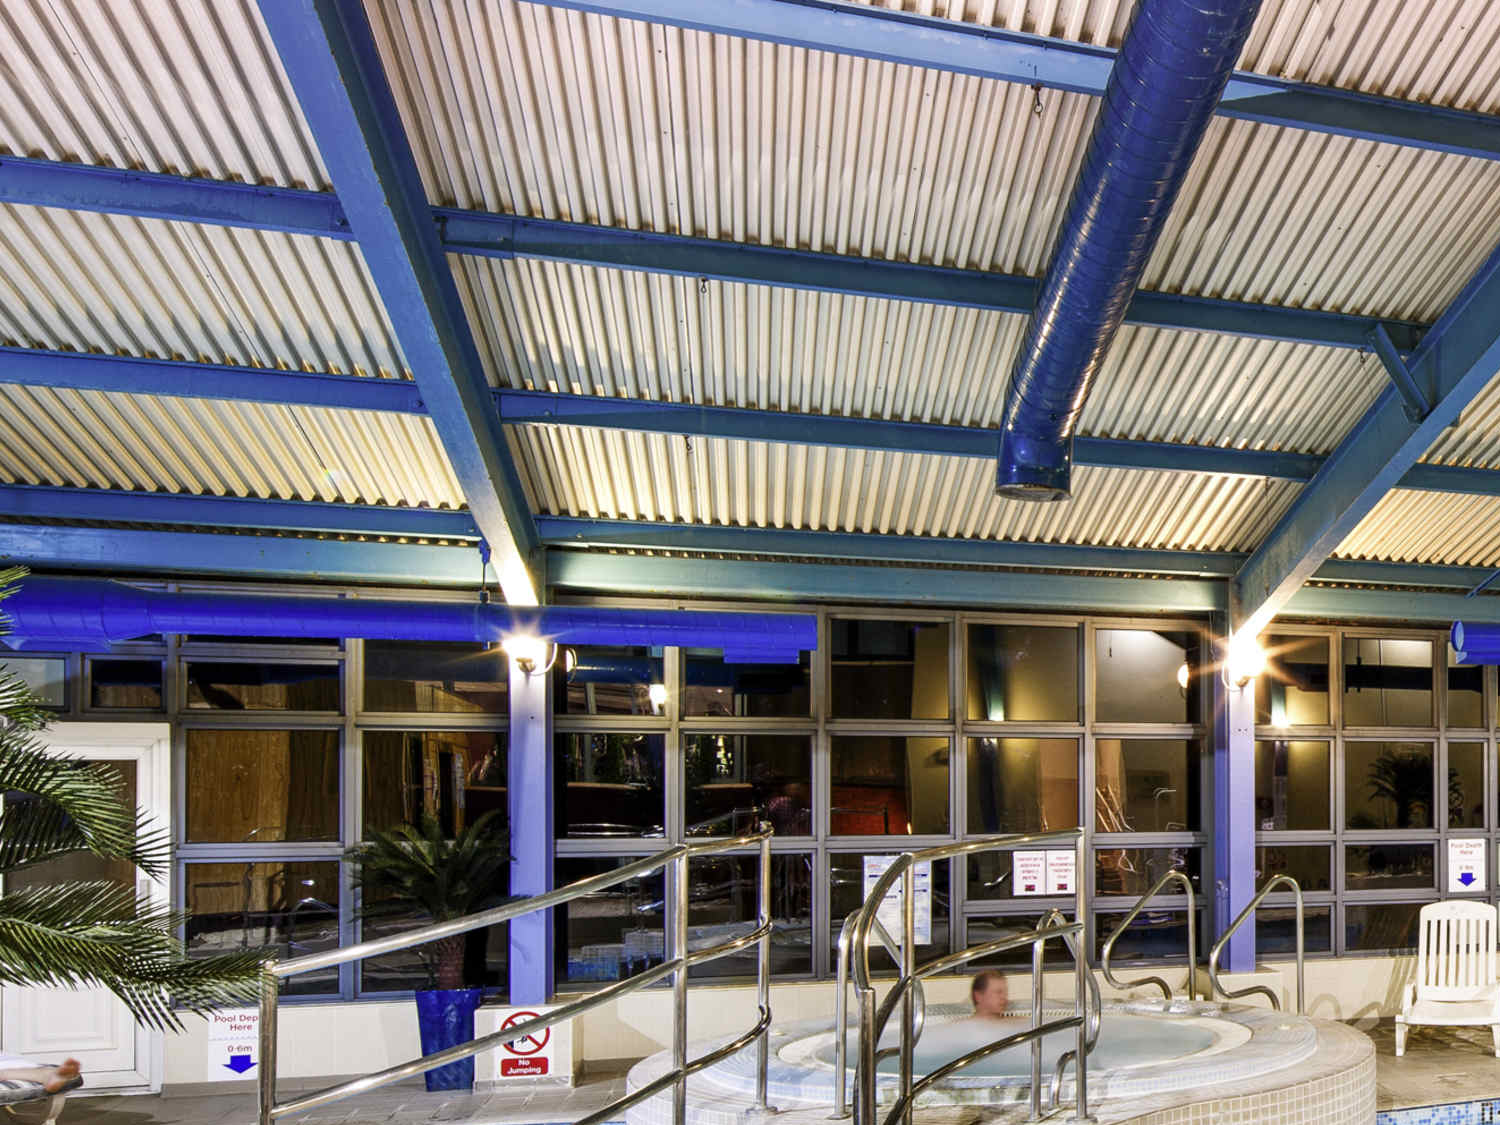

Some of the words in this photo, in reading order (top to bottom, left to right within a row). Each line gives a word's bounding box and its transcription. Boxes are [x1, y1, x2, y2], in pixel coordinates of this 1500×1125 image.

[214, 1014, 236, 1023] Pool
[239, 1014, 259, 1023] Dep
[507, 1066, 542, 1074] Jumping
